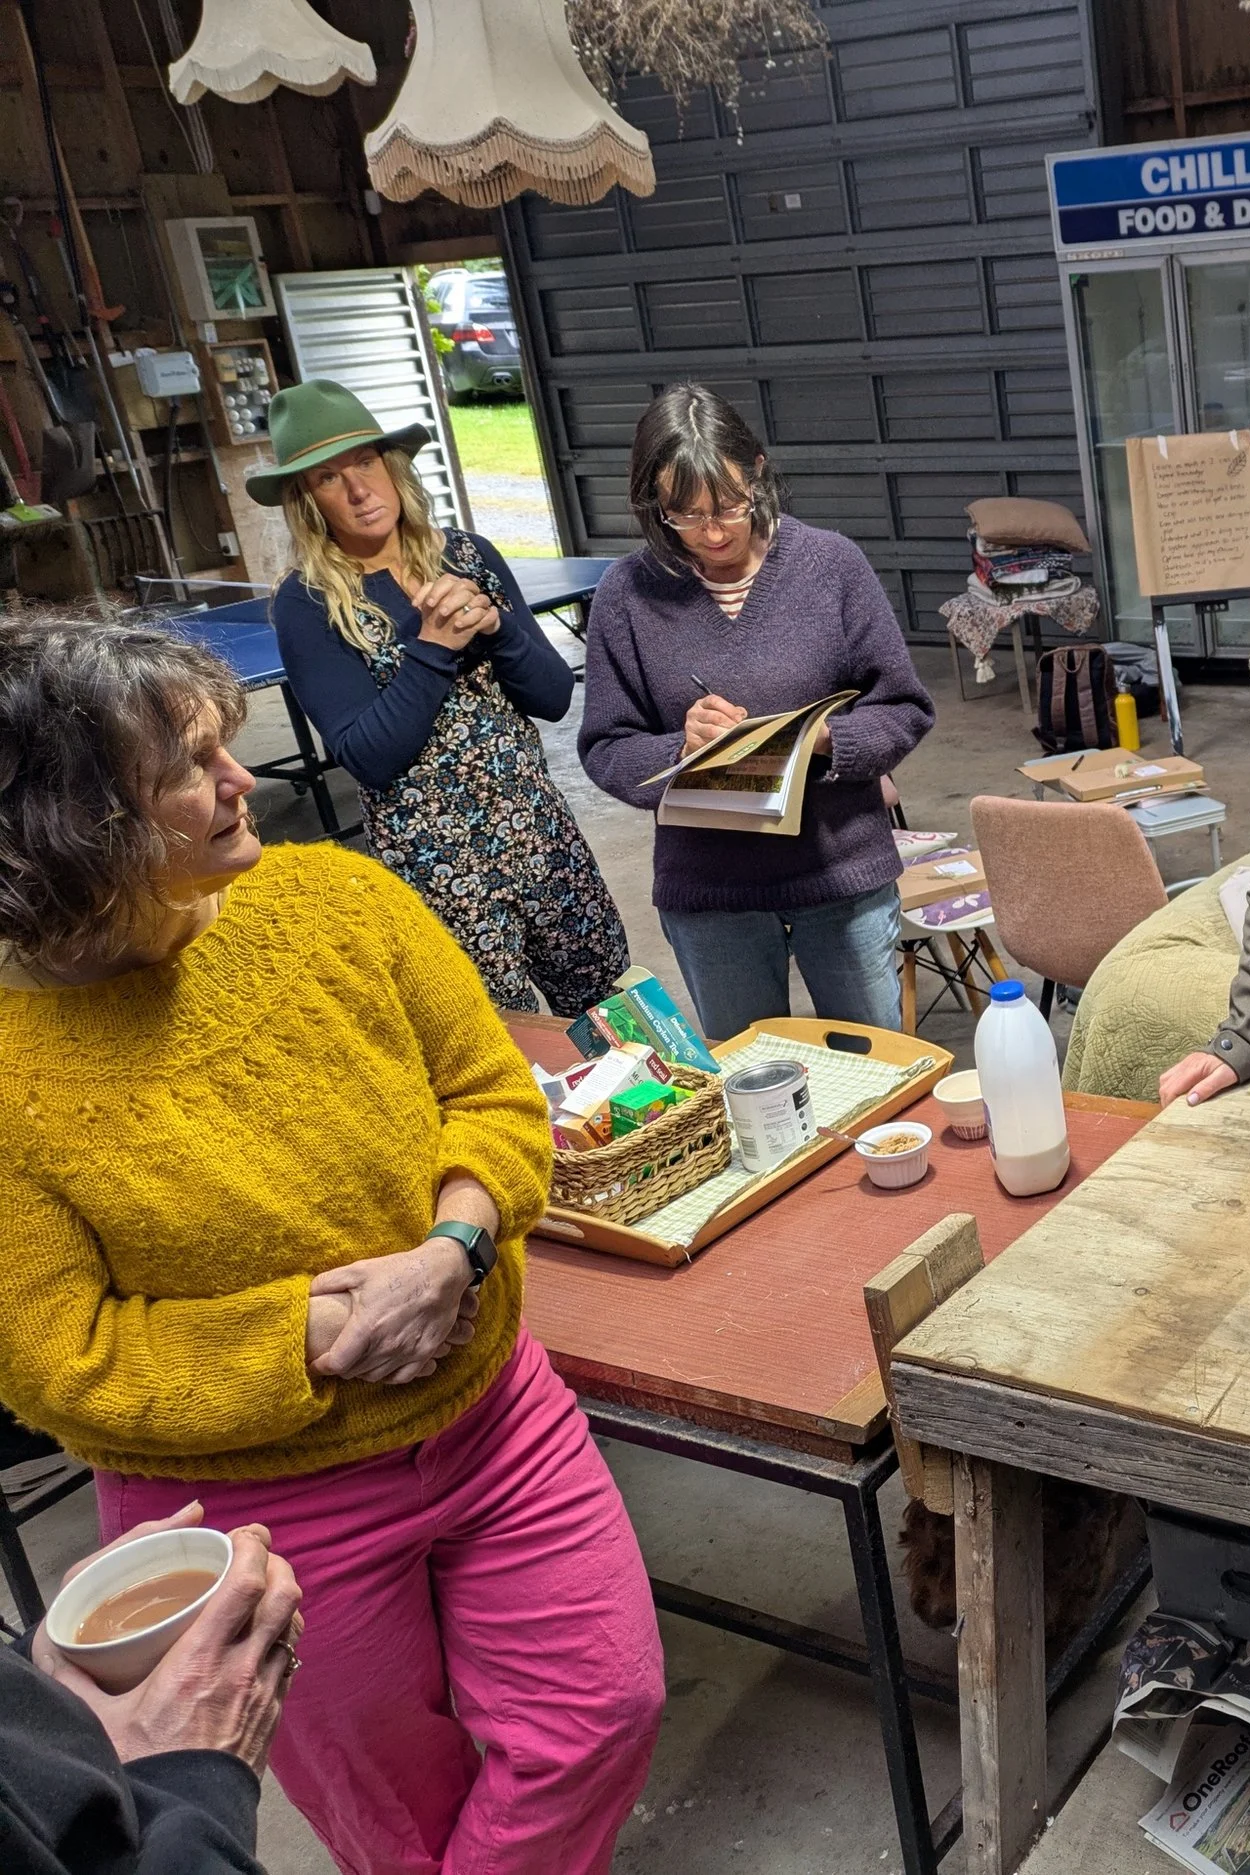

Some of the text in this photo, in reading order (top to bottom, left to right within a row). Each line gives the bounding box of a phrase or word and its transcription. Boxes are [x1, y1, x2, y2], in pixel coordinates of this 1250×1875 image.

[1118, 203, 1196, 235] FOOD
[1205, 201, 1226, 228] &
[631, 989, 680, 1056] Premium Ceylon Tea
[649, 1059, 660, 1070] red
